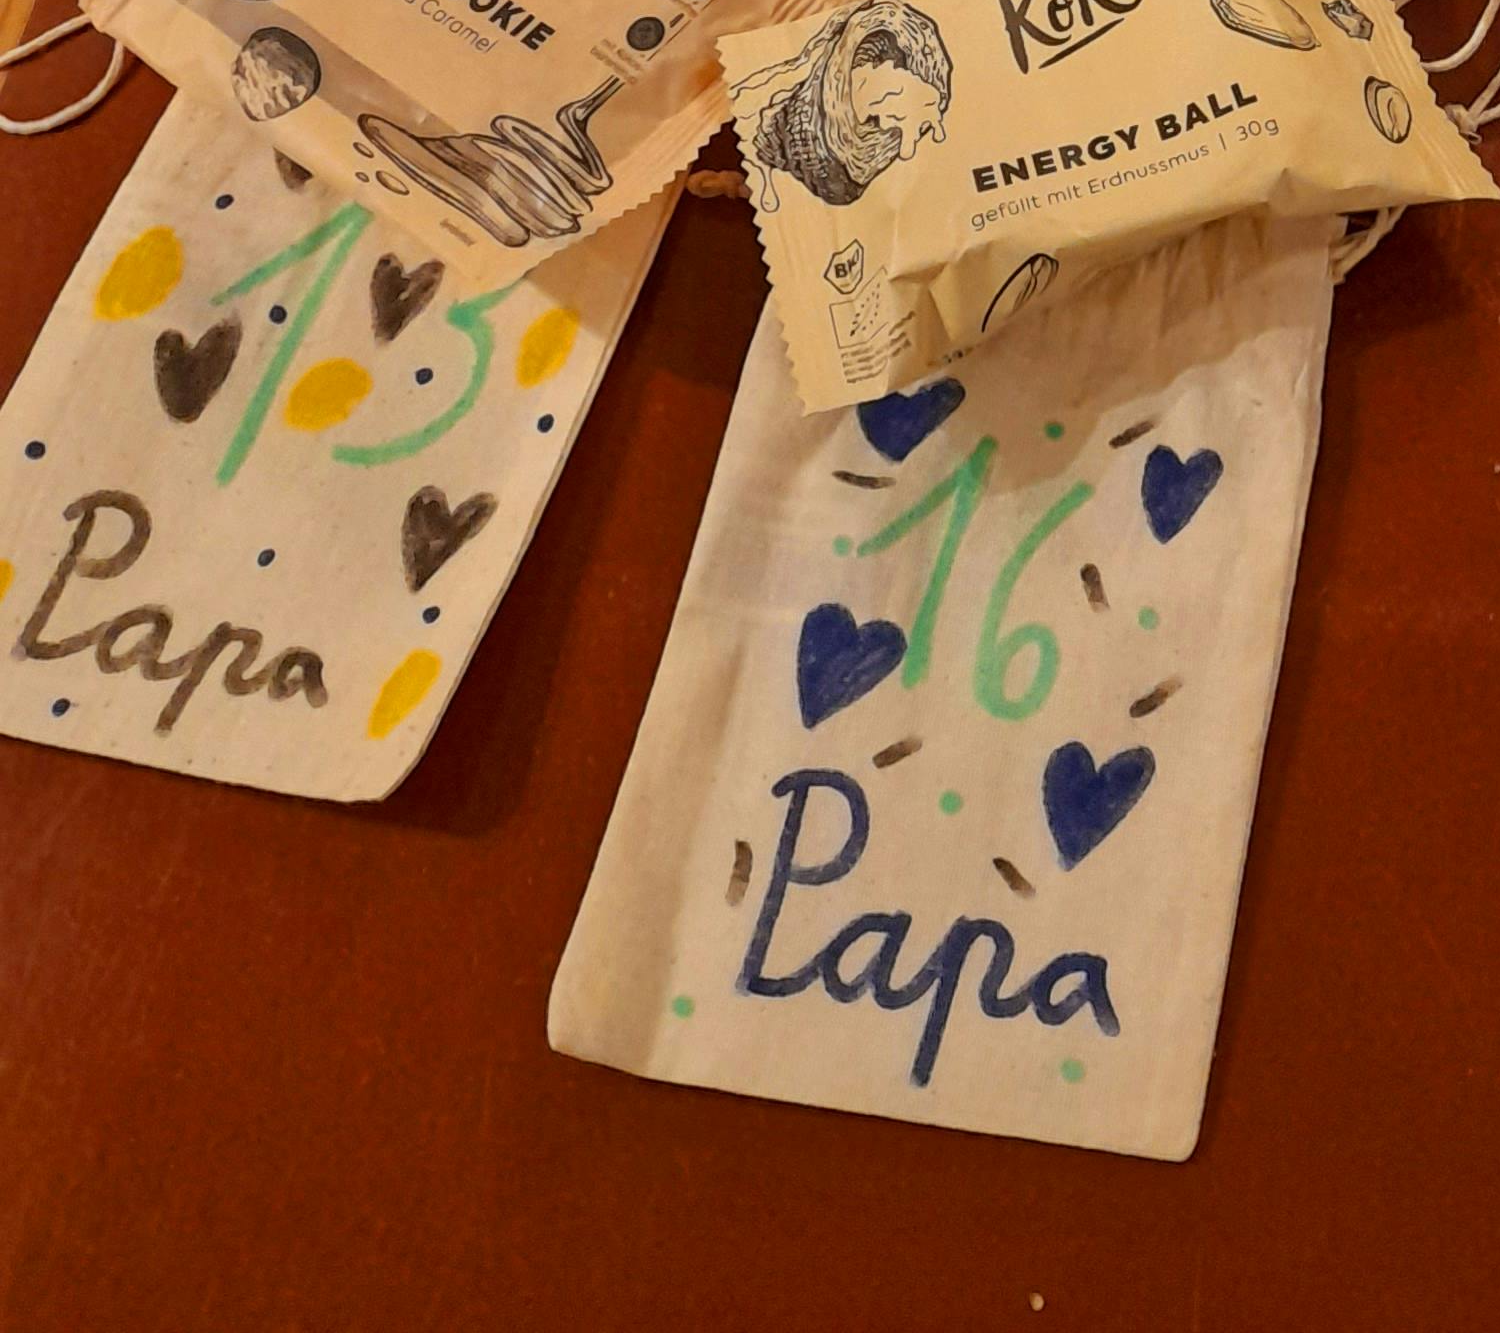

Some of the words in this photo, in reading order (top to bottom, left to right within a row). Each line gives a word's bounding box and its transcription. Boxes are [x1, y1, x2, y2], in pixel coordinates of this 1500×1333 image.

[971, 193, 1040, 232] gefüllt
[1047, 183, 1081, 206] mit
[1087, 144, 1209, 195] Erdnussmus
[972, 125, 1139, 193] ENERGY
[1155, 83, 1257, 141] BALL
[11, 489, 328, 737] Papa
[857, 436, 1094, 722] 16
[736, 768, 1121, 1089] Papa
